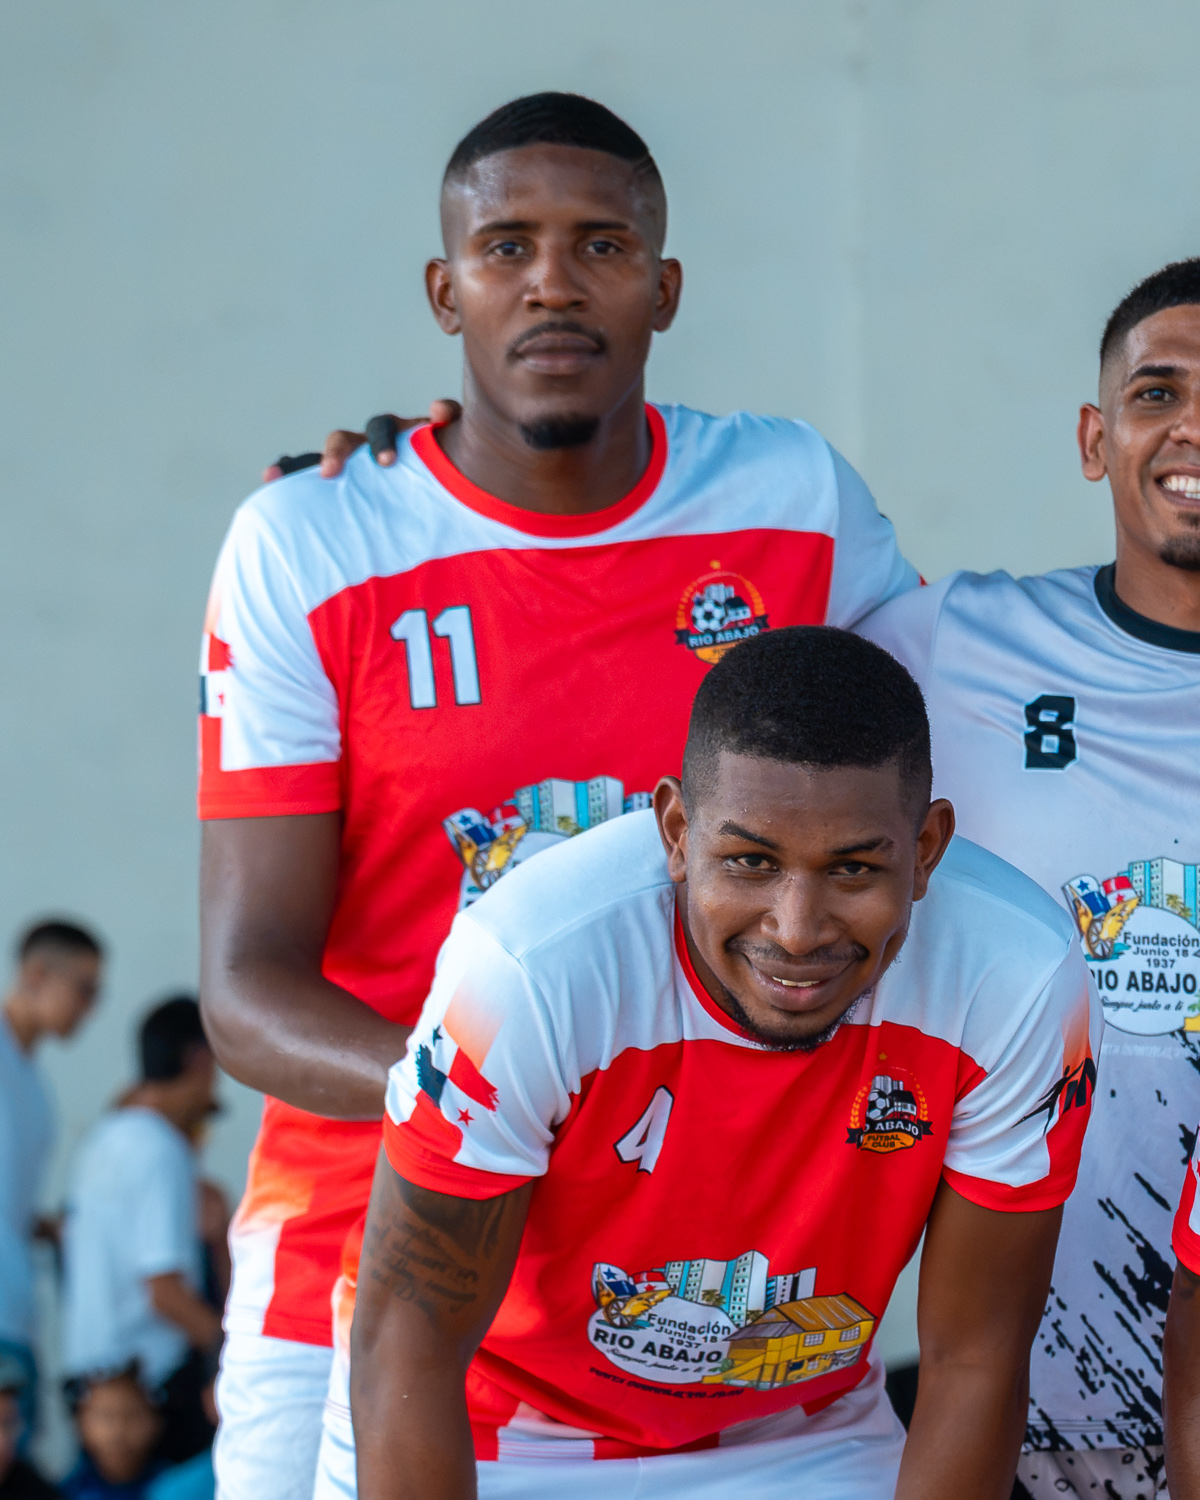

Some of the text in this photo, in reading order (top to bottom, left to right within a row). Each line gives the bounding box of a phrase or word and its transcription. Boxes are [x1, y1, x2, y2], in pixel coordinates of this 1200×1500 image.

[688, 625, 760, 648] RIO ABAJO
[389, 604, 482, 710] 11
[1023, 693, 1078, 770] 8
[1123, 932, 1200, 948] Fundación
[1132, 947, 1190, 958] Junio 18
[1146, 958, 1176, 969] 1937
[1090, 968, 1197, 994] IO ABAJO
[612, 1083, 676, 1176] 4
[875, 1120, 919, 1136] ABAJO
[647, 1312, 731, 1336] Fundación
[655, 1326, 718, 1344] Junio 18
[593, 1328, 723, 1364] RIO ABAJO
[668, 1336, 702, 1350] 1937
